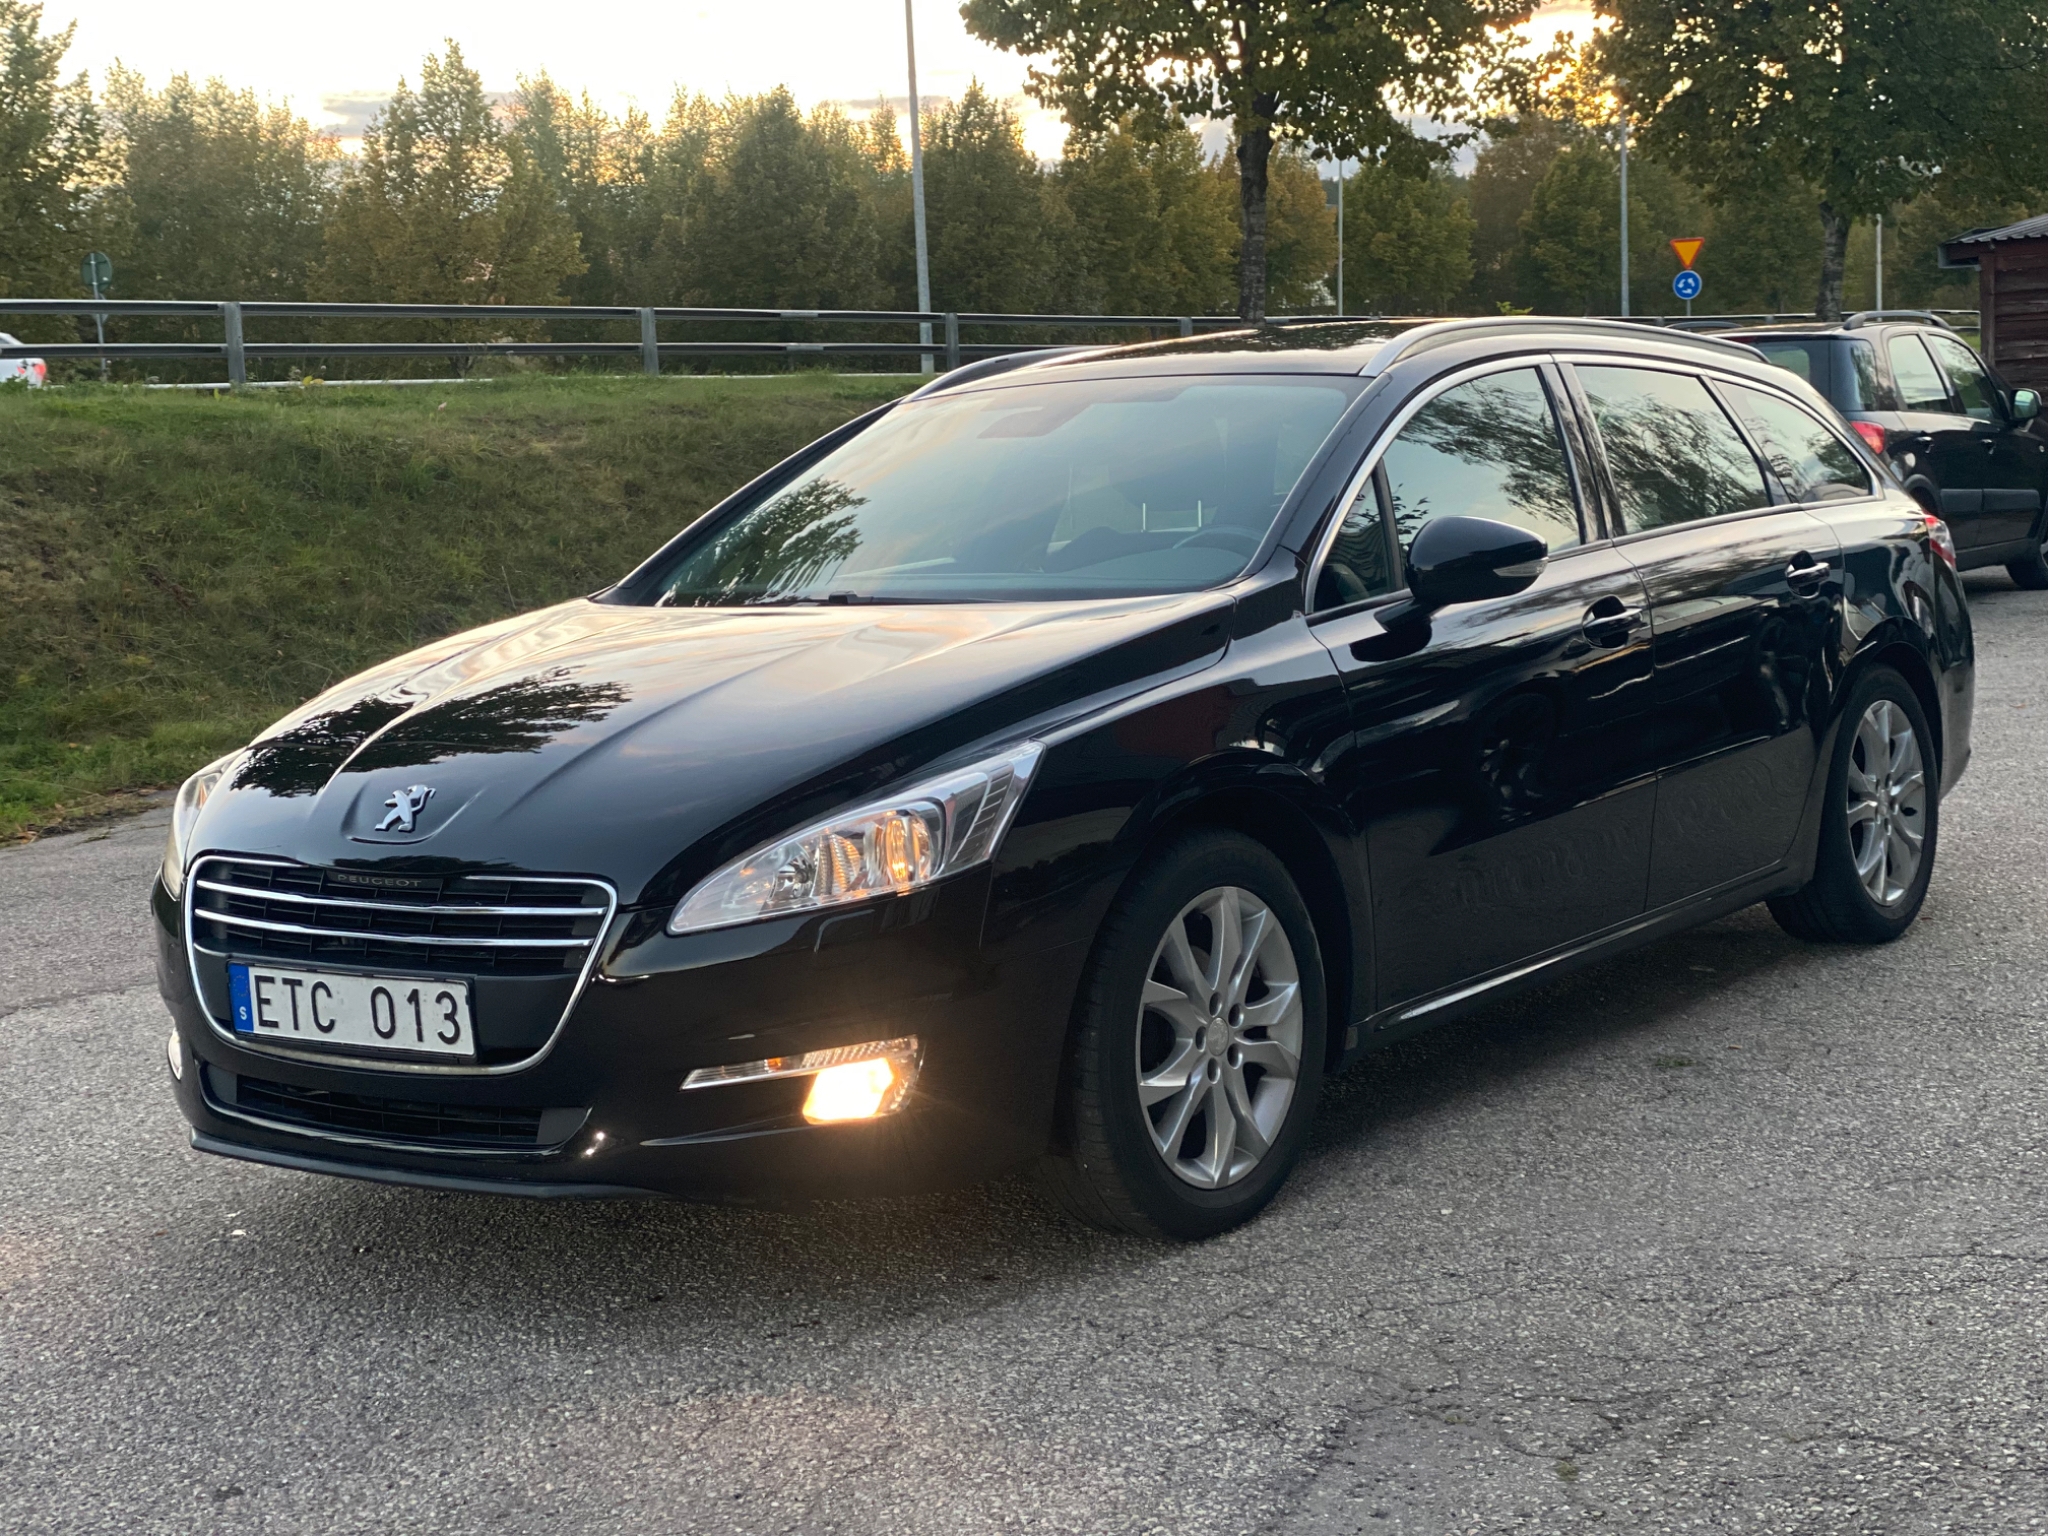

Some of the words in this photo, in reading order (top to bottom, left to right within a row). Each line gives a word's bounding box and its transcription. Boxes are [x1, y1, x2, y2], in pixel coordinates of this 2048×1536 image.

[337, 874, 422, 887] PEUGEOT
[239, 1006, 248, 1021] S
[254, 974, 336, 1034] ETC
[370, 986, 461, 1045] 013
